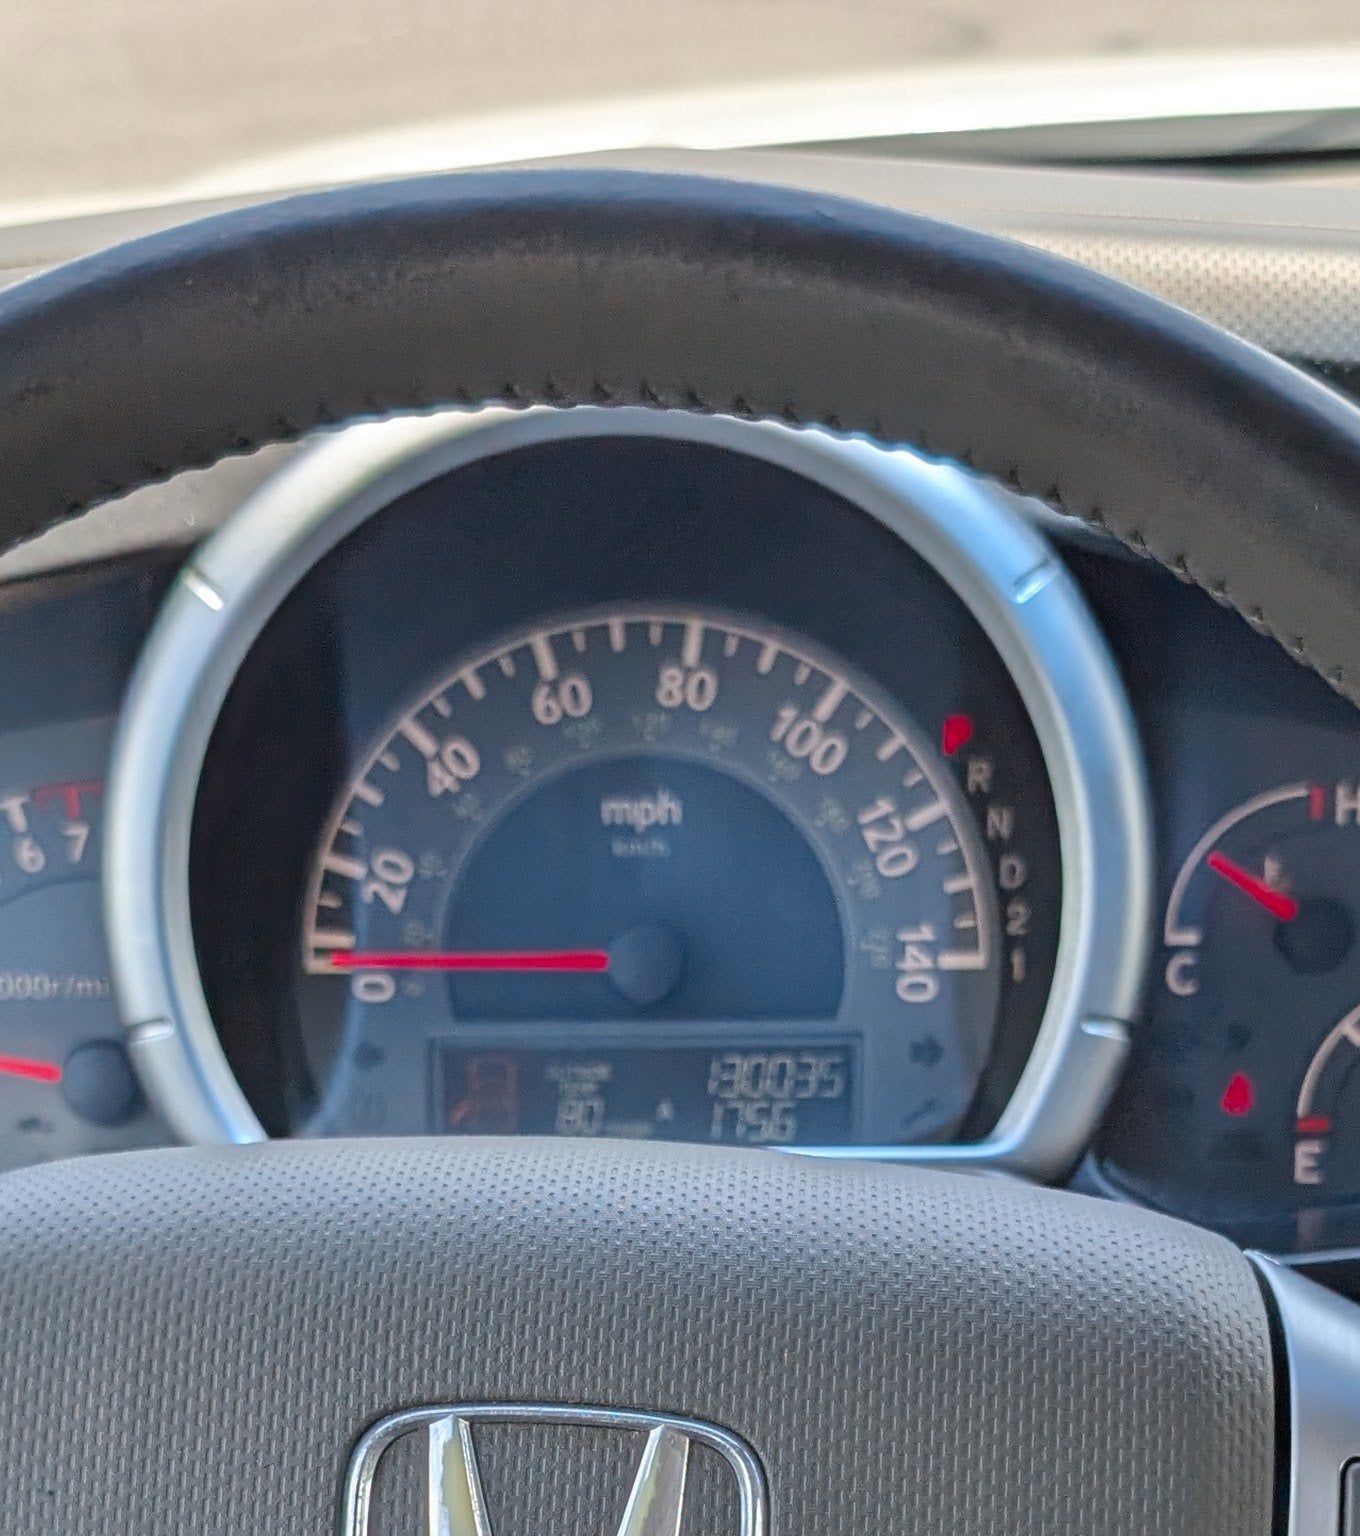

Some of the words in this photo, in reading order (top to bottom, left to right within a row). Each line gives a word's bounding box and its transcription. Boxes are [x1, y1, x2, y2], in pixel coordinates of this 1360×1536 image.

[531, 675, 593, 726] 60
[655, 667, 718, 712] 80
[769, 703, 848, 776] 100
[424, 736, 483, 798] 40
[600, 788, 683, 831] mph
[13, 839, 46, 873] 6
[61, 824, 91, 863] 7
[855, 797, 918, 878] 120
[360, 849, 416, 915] 20
[895, 923, 938, 1003] 140
[1165, 952, 1197, 995] C
[351, 971, 397, 1002] 0
[1293, 1139, 1324, 1184] E
